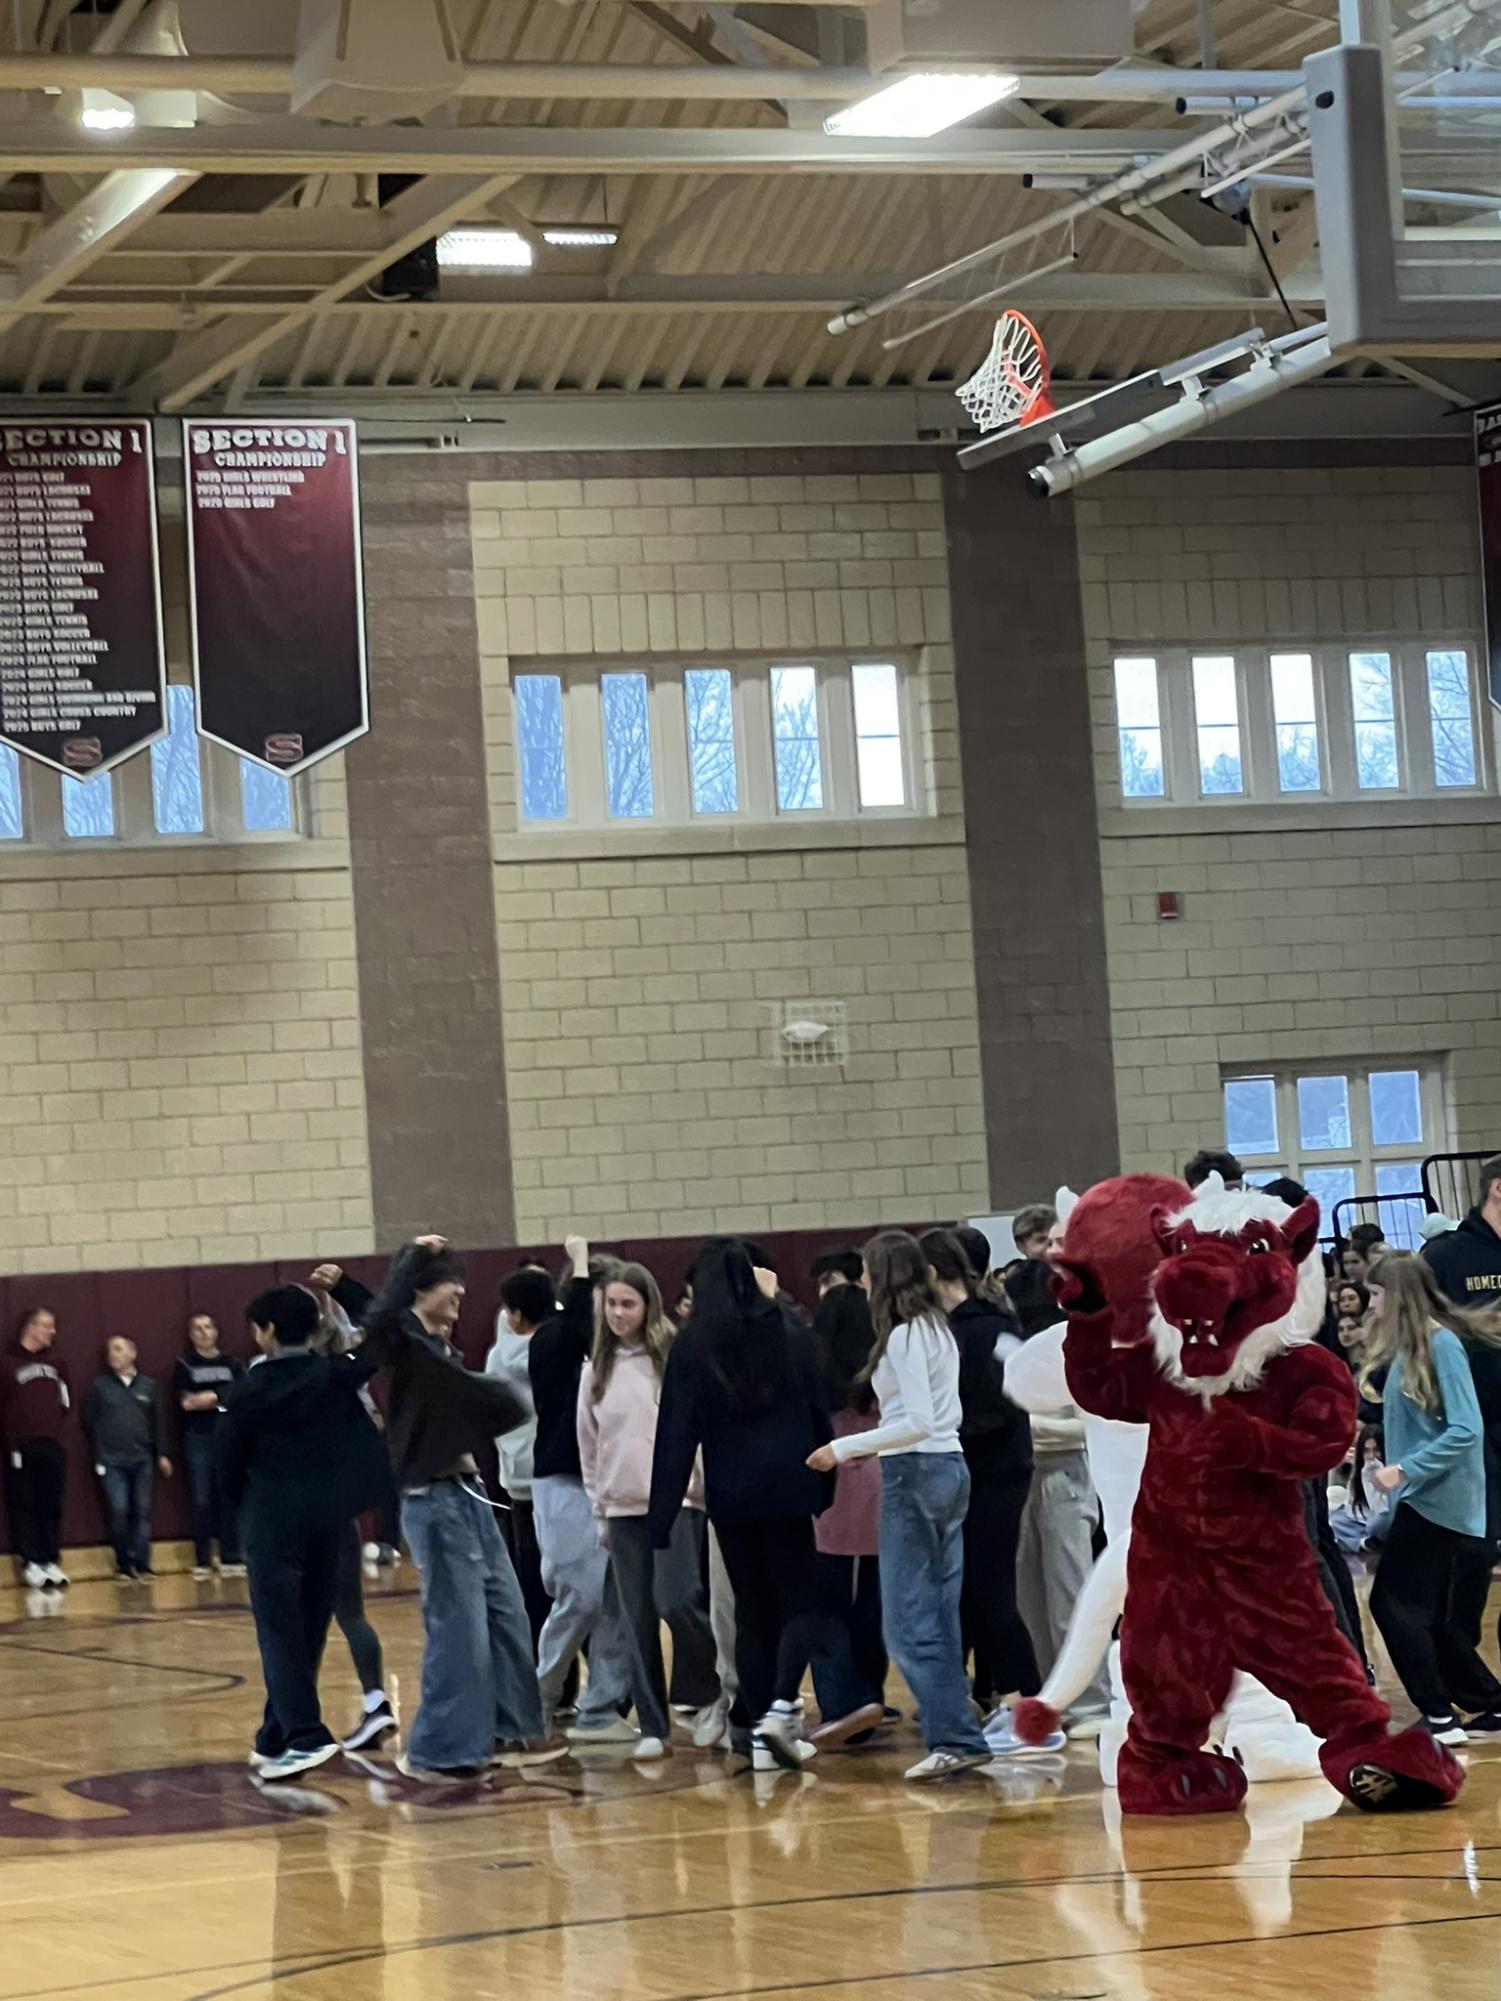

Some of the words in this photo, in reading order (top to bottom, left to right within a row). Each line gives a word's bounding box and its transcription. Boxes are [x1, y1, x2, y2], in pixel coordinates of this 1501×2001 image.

[130, 430, 143, 453] 1
[193, 428, 328, 454] SECTION
[333, 430, 347, 455] 1
[8, 451, 122, 467] CHAMPIONSHIP
[214, 451, 327, 467] CHAMPIONSHIP
[248, 484, 292, 496] FOOTBALL
[48, 562, 104, 574] VOLLEYBALL
[53, 640, 110, 651] VOLLEYBALL
[52, 654, 98, 665] FOOTBALL
